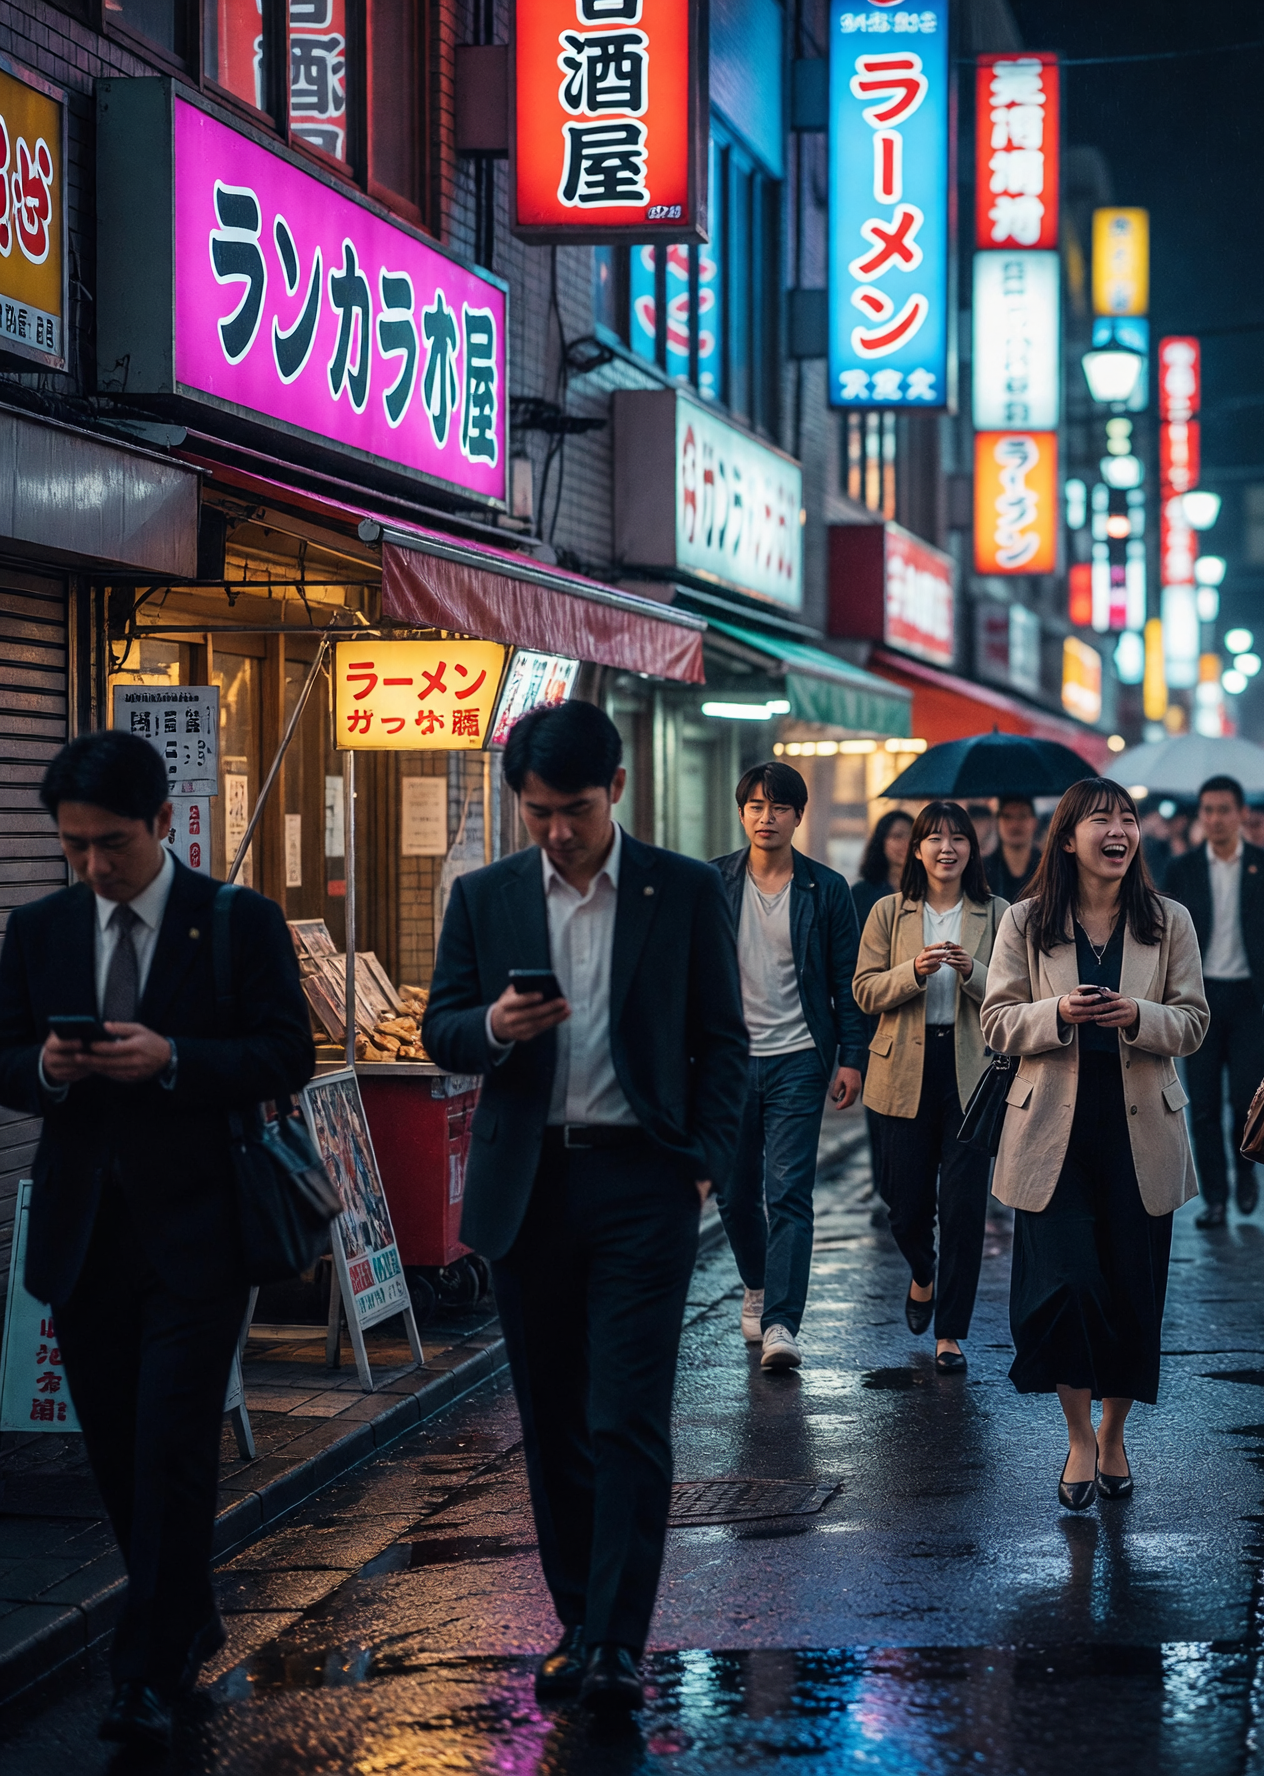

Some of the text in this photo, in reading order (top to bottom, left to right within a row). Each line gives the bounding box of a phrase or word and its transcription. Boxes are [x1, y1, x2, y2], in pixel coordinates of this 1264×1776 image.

[850, 51, 928, 359] ラーメン
[346, 660, 487, 701] ラーメン
